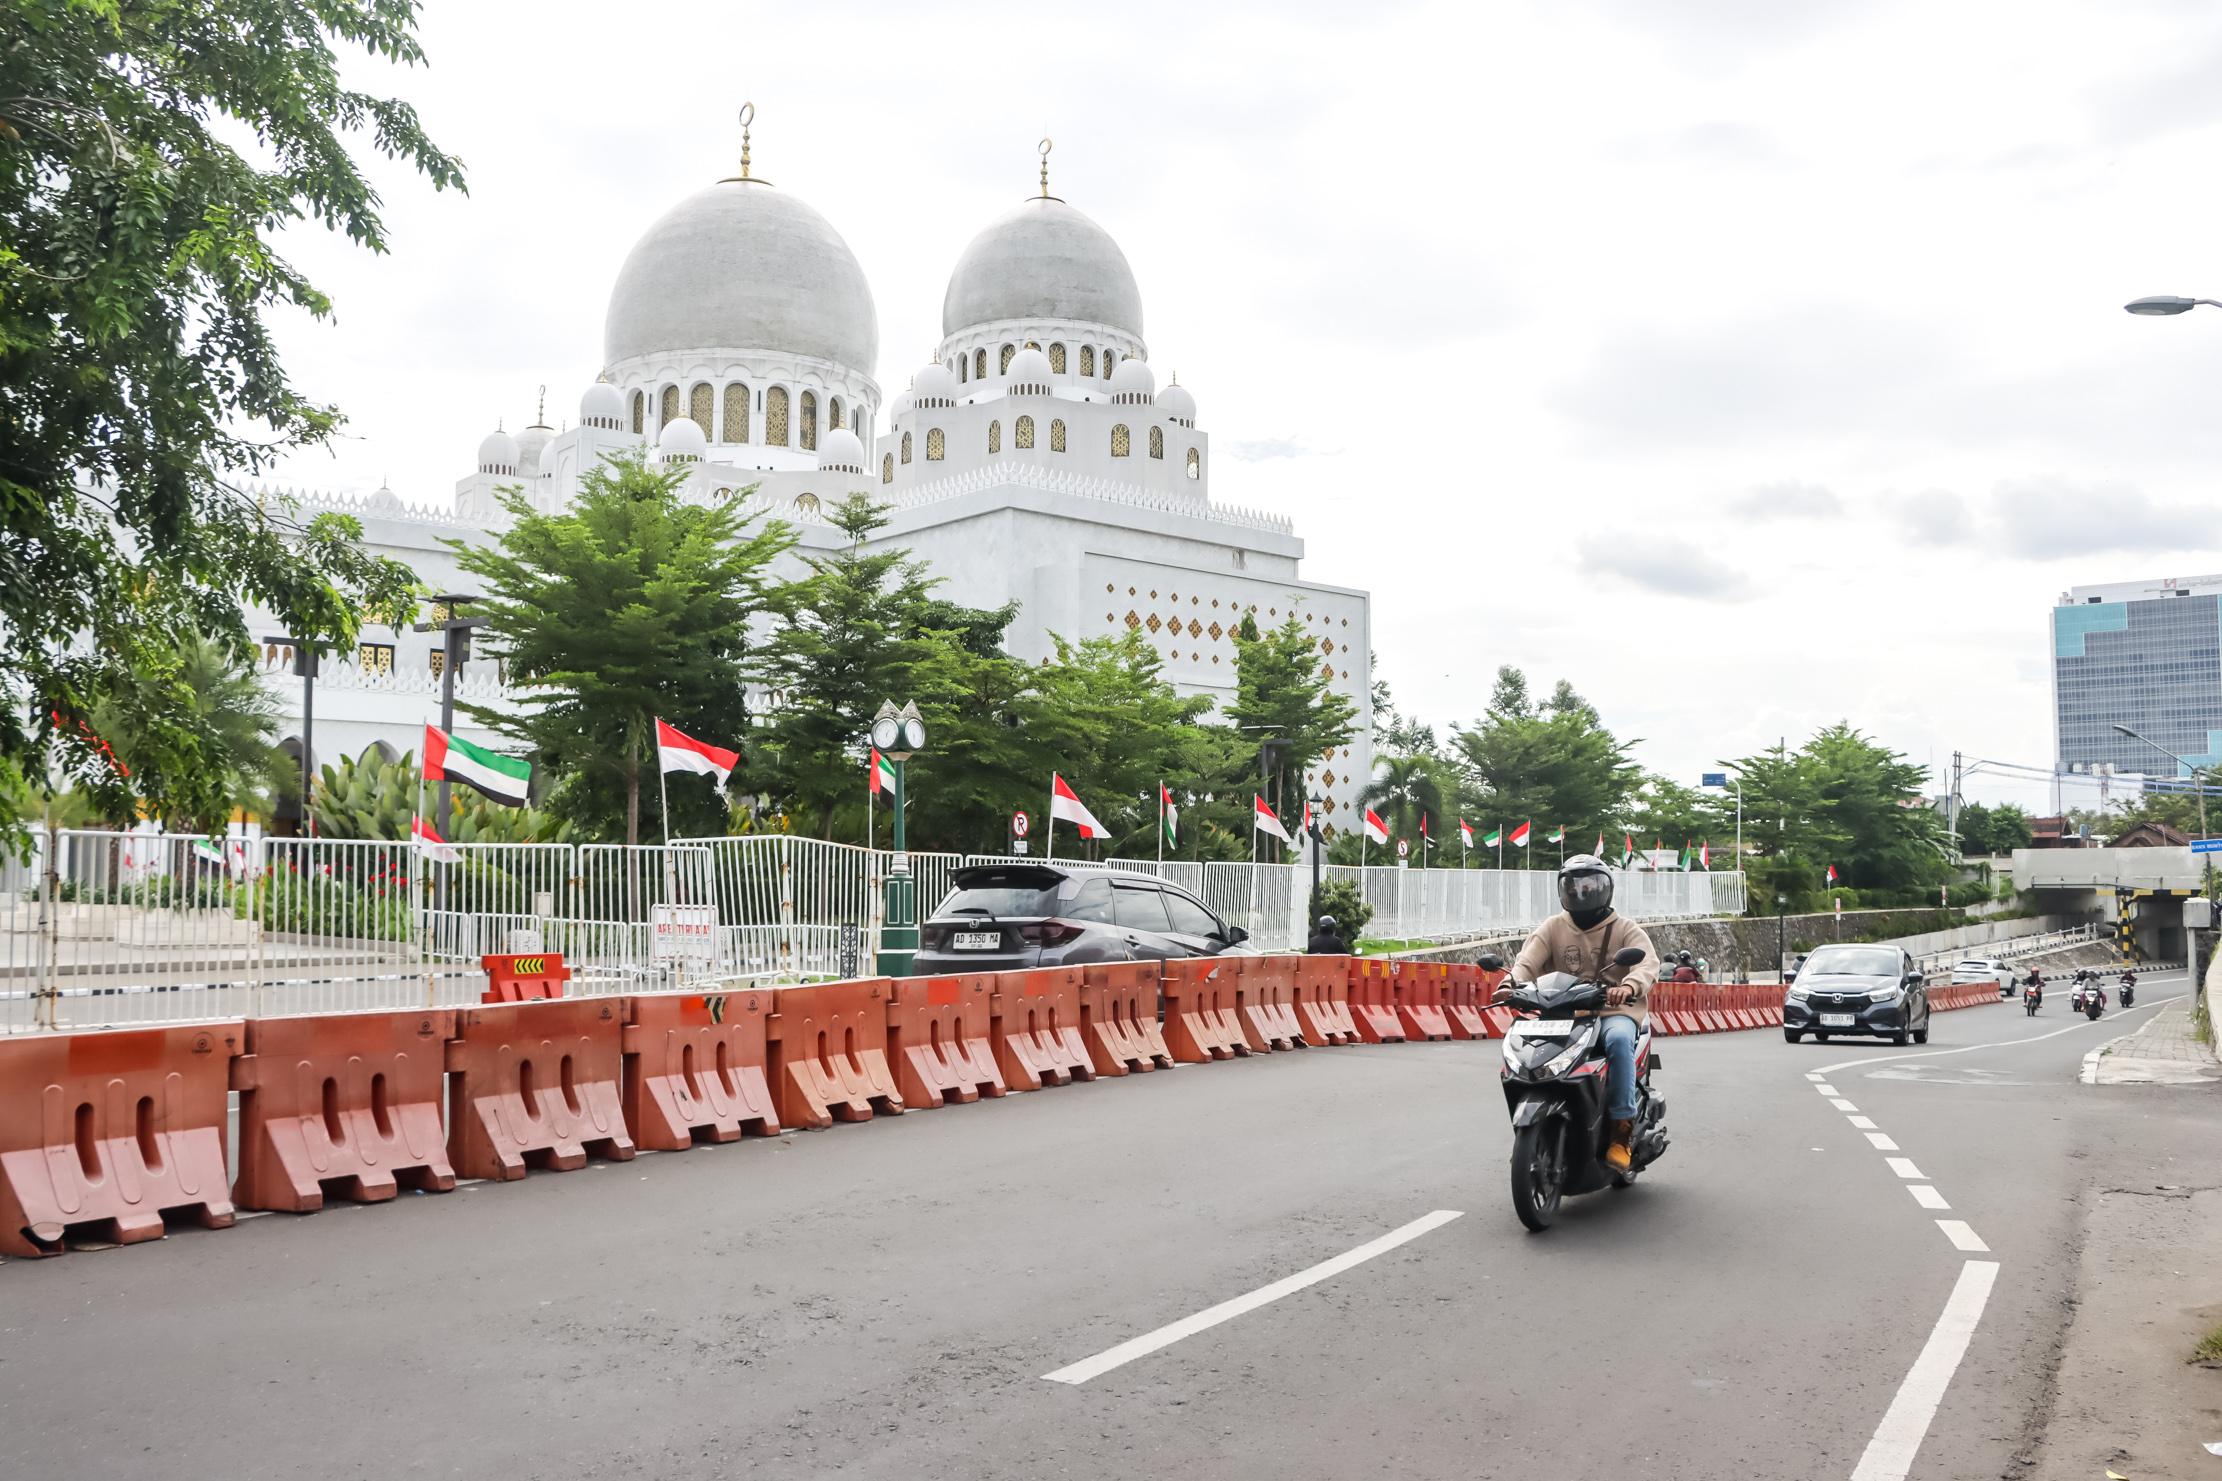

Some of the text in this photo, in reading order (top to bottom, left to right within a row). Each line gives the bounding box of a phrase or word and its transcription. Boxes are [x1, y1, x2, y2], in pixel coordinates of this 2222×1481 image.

[955, 933, 999, 944] AD 1350 MA
